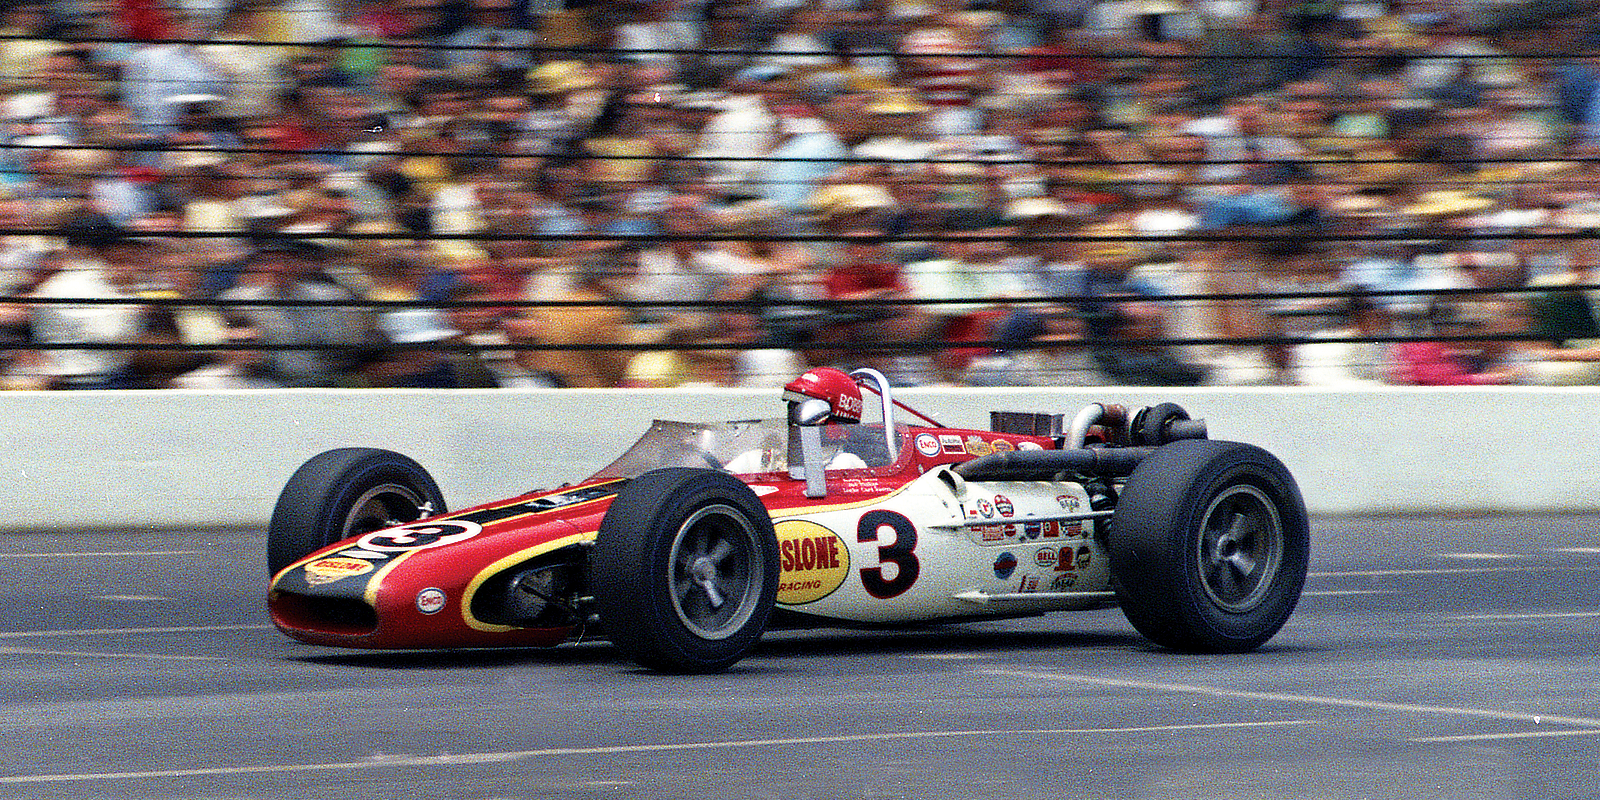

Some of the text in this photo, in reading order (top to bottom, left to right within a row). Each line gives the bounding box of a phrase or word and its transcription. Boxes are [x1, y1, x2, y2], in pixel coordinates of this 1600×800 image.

[779, 536, 840, 572] SLONE
[857, 509, 920, 599] 3
[778, 580, 821, 591] RACING
